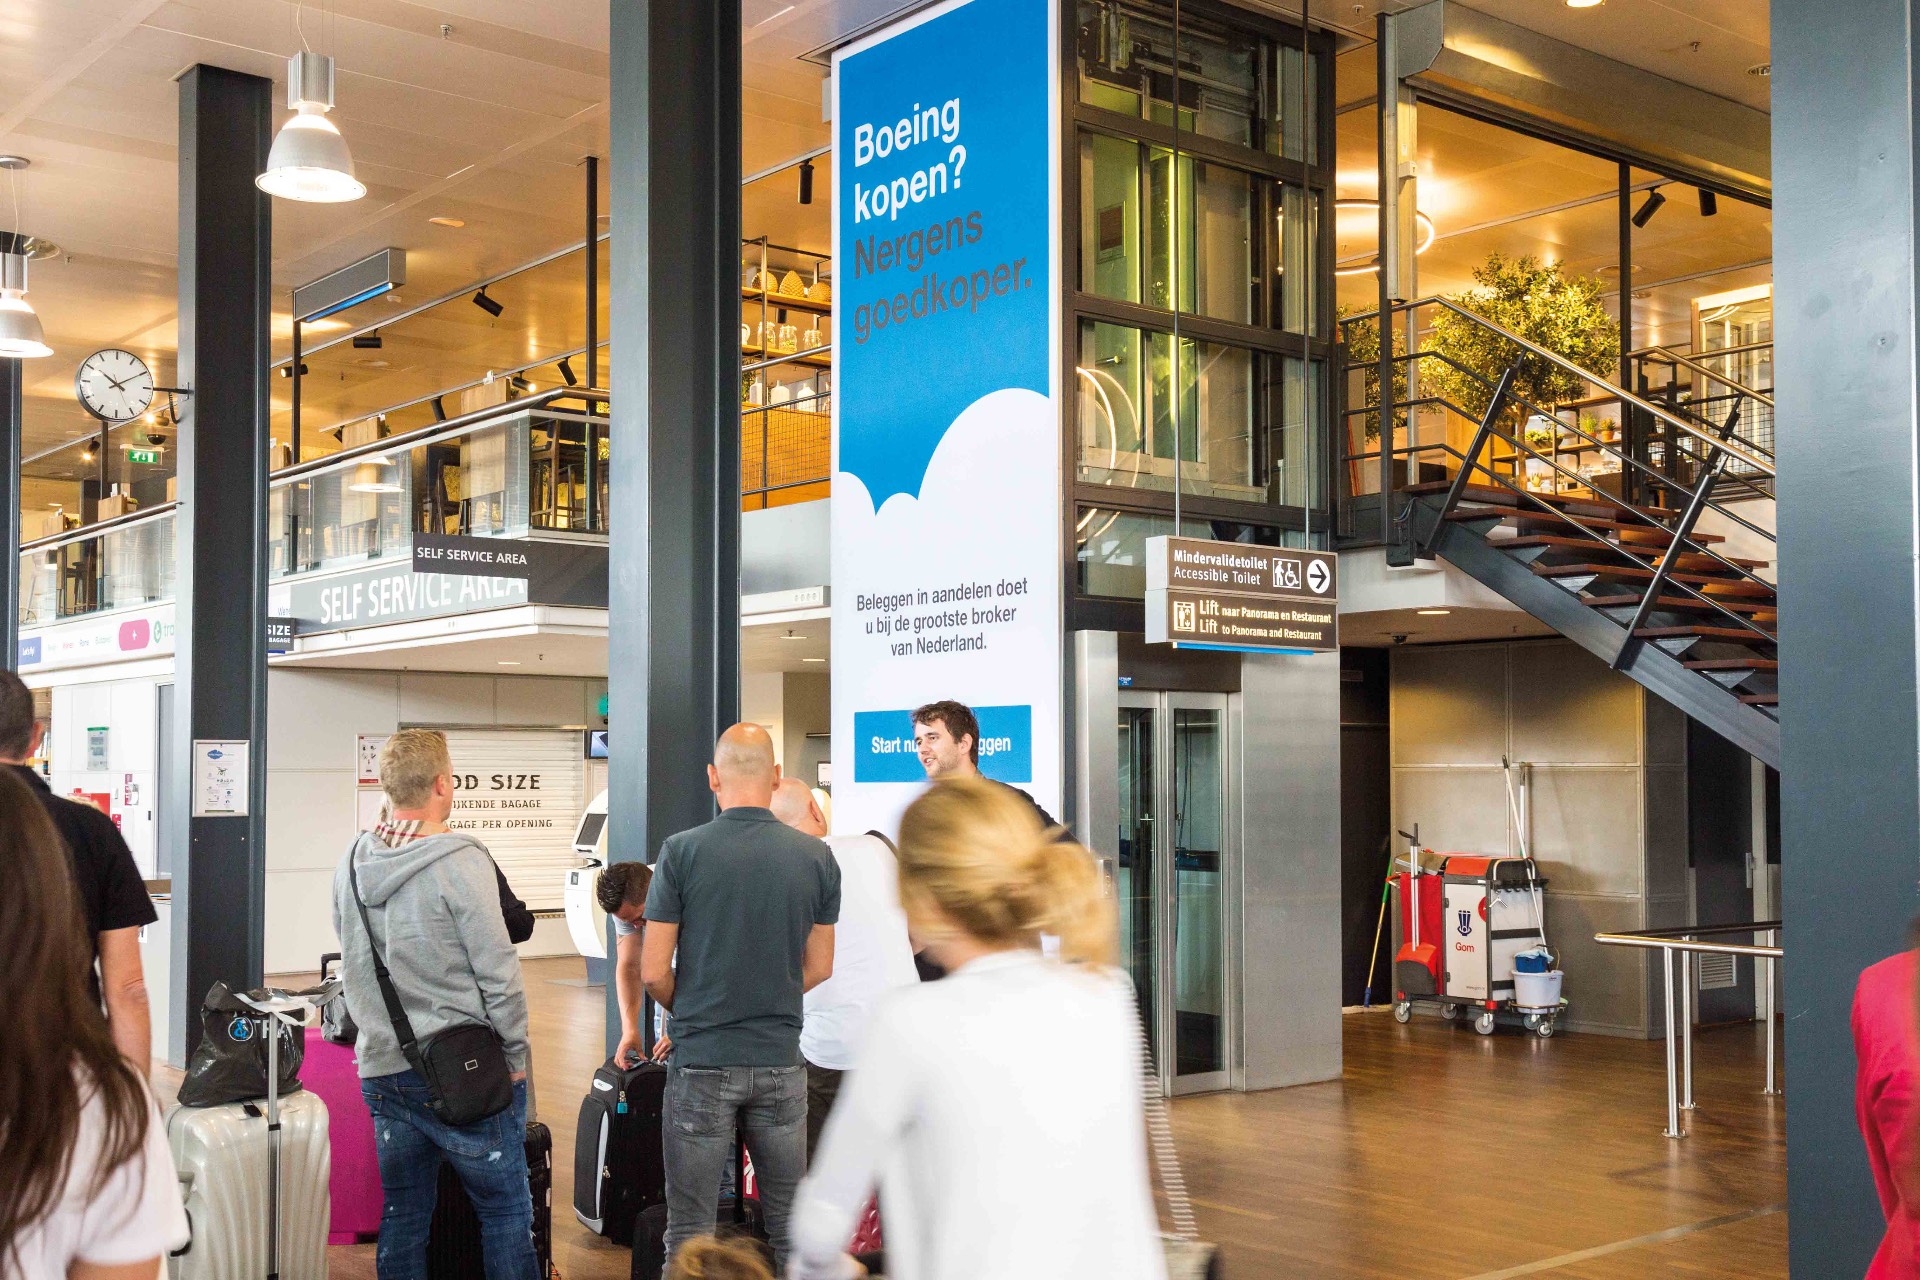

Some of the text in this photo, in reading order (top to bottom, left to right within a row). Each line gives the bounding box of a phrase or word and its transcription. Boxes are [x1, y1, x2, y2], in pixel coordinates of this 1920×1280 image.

[854, 97, 960, 168] Boeing
[854, 144, 967, 224] kopen?
[855, 210, 983, 279] Nergens
[854, 256, 1032, 344] goedkoper.
[417, 546, 528, 565] SELF SERVICE AREA
[1173, 549, 1268, 571] Mindervalidetoilet
[1174, 565, 1261, 585] Accessible Toilet
[320, 582, 363, 625] SELF
[367, 572, 452, 618] SERVICE
[856, 577, 1028, 613] Beleggen in aandelen doet
[866, 605, 1017, 637] u bij de grootste broker
[1199, 599, 1332, 624] Lift naar Panorama en Restaurant
[1199, 618, 1322, 641] Lift to Panorama and Restaurant
[891, 632, 987, 656] van Nederland.
[871, 735, 1011, 756] Start nu ggen
[490, 774, 541, 790] SIZE
[501, 799, 541, 809] BAGAGE
[482, 820, 502, 829] PER
[506, 819, 553, 829] OPENING
[1455, 941, 1475, 953] Gom
